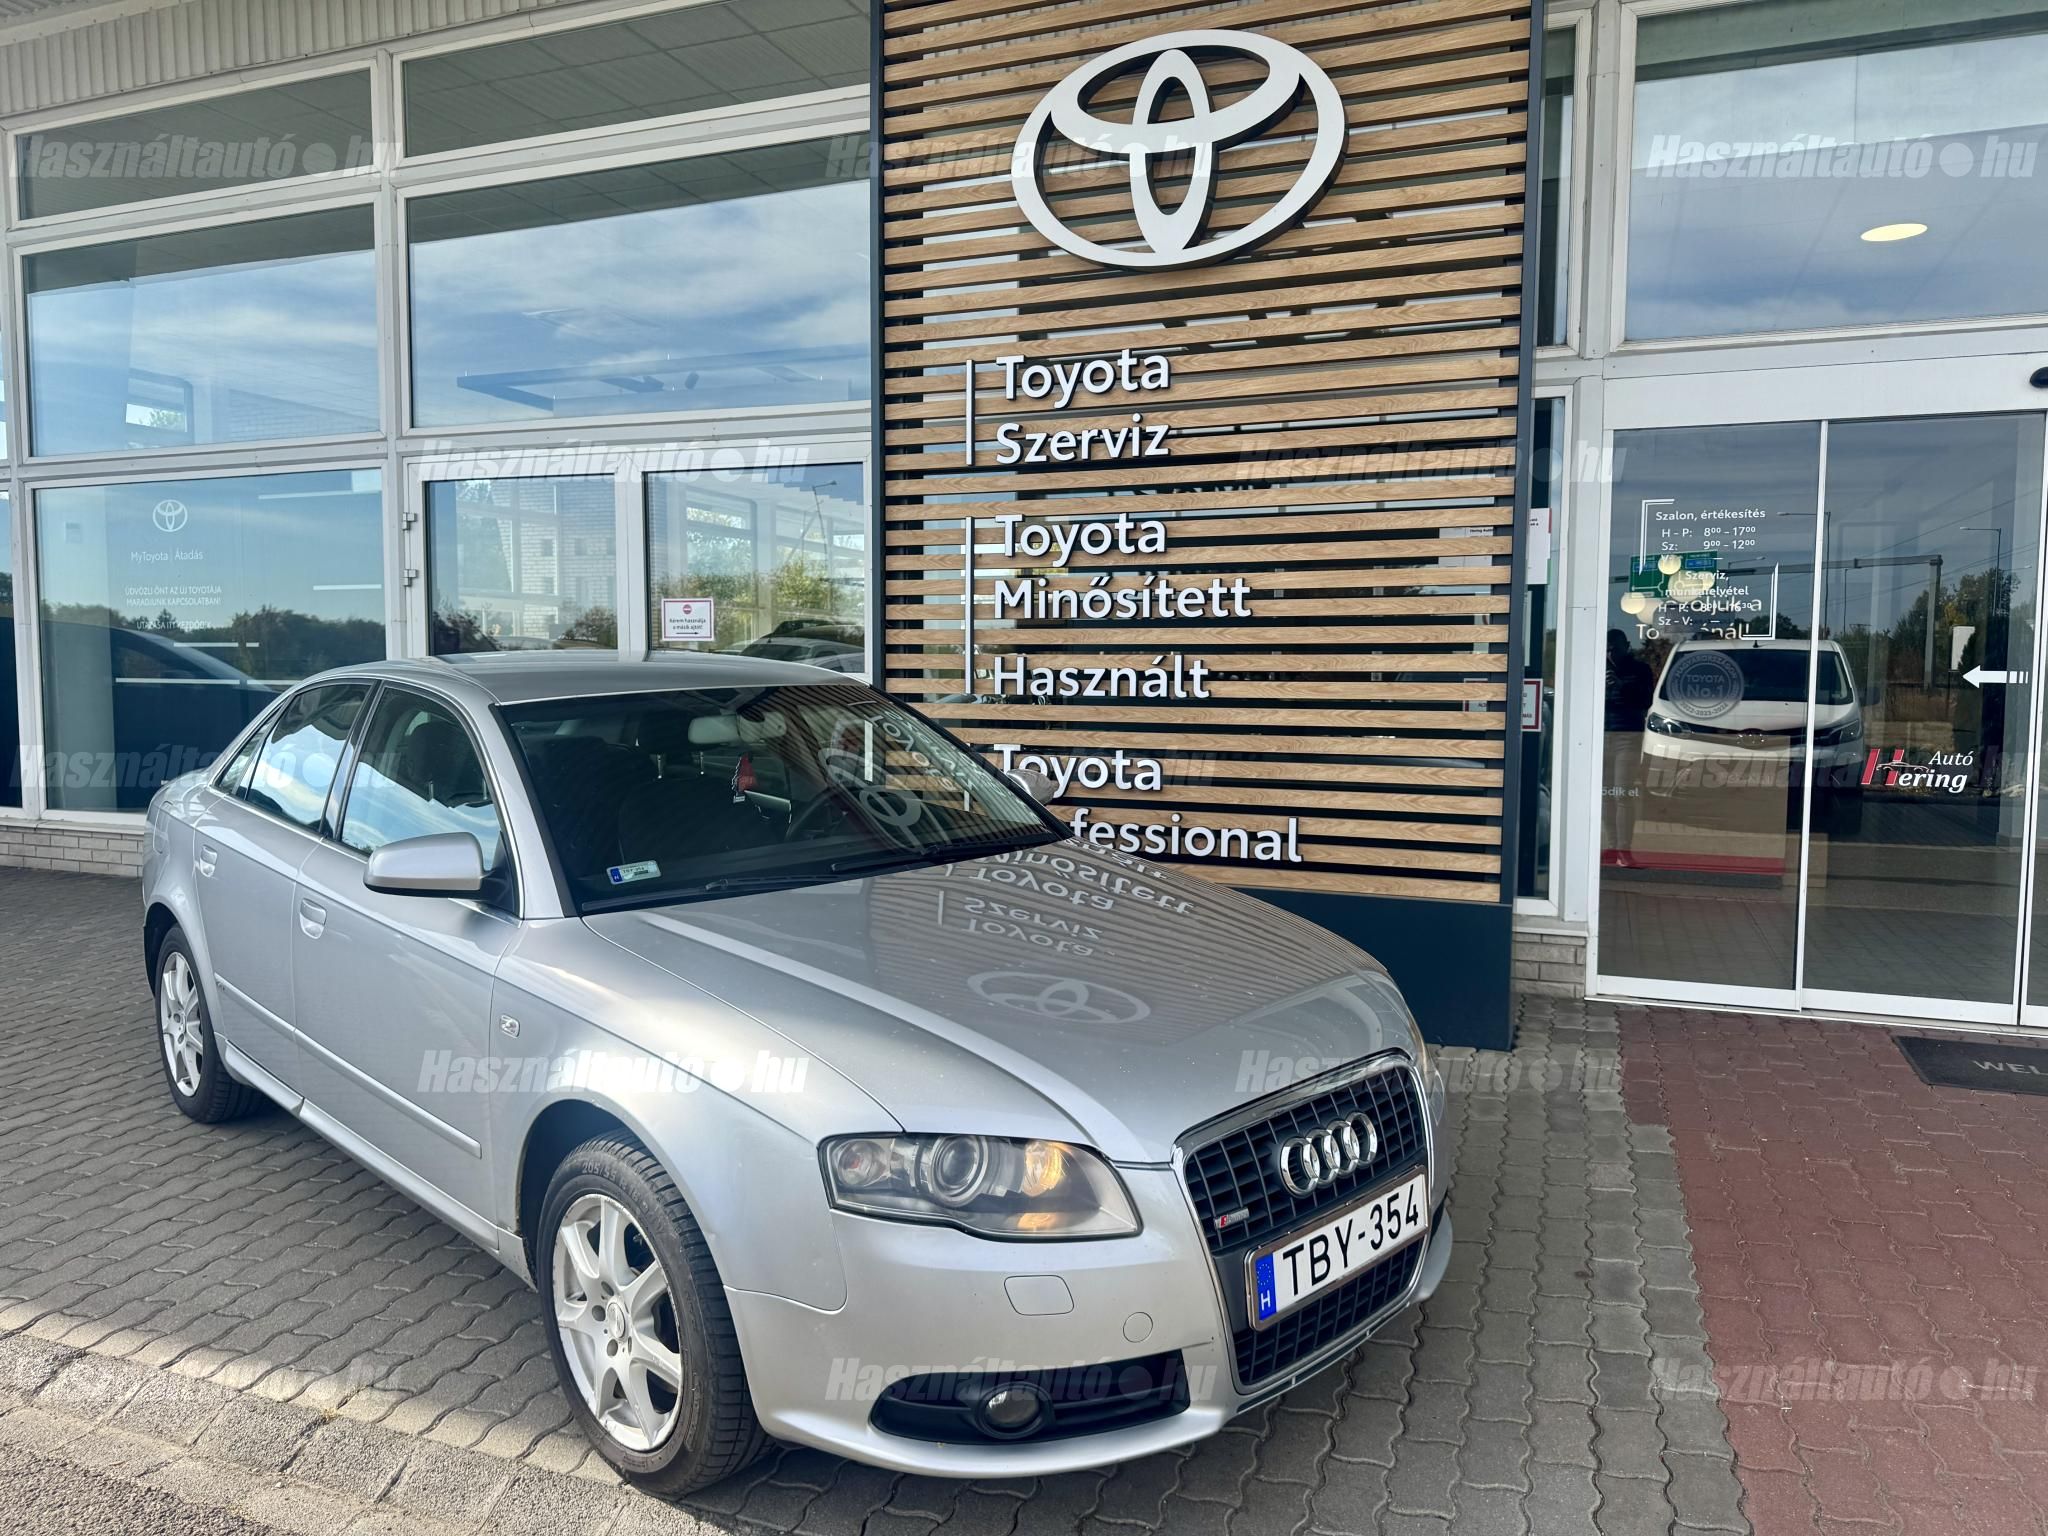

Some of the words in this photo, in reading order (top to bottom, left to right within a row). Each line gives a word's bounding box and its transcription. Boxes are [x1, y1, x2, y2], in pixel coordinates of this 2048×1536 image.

[996, 348, 1171, 409] Toyota
[996, 413, 1170, 465] Szerviz
[1655, 510, 1698, 521] Szalon,
[1700, 507, 1766, 519] értékesítés
[995, 512, 1168, 568] Toyota
[1661, 528, 1671, 538] H
[1682, 528, 1693, 538] P:
[130, 551, 169, 563] MyToyota
[1661, 541, 1678, 551] Sz:
[994, 575, 1252, 619] Minősített
[994, 654, 1210, 699] Használt
[1687, 674, 1725, 684] TOYOTA
[1687, 684, 1724, 698] No.1
[1928, 750, 1975, 766] Autó
[994, 744, 1162, 799] Toyota
[1282, 1183, 1420, 1297] TBY-354
[1261, 1290, 1271, 1312] H
